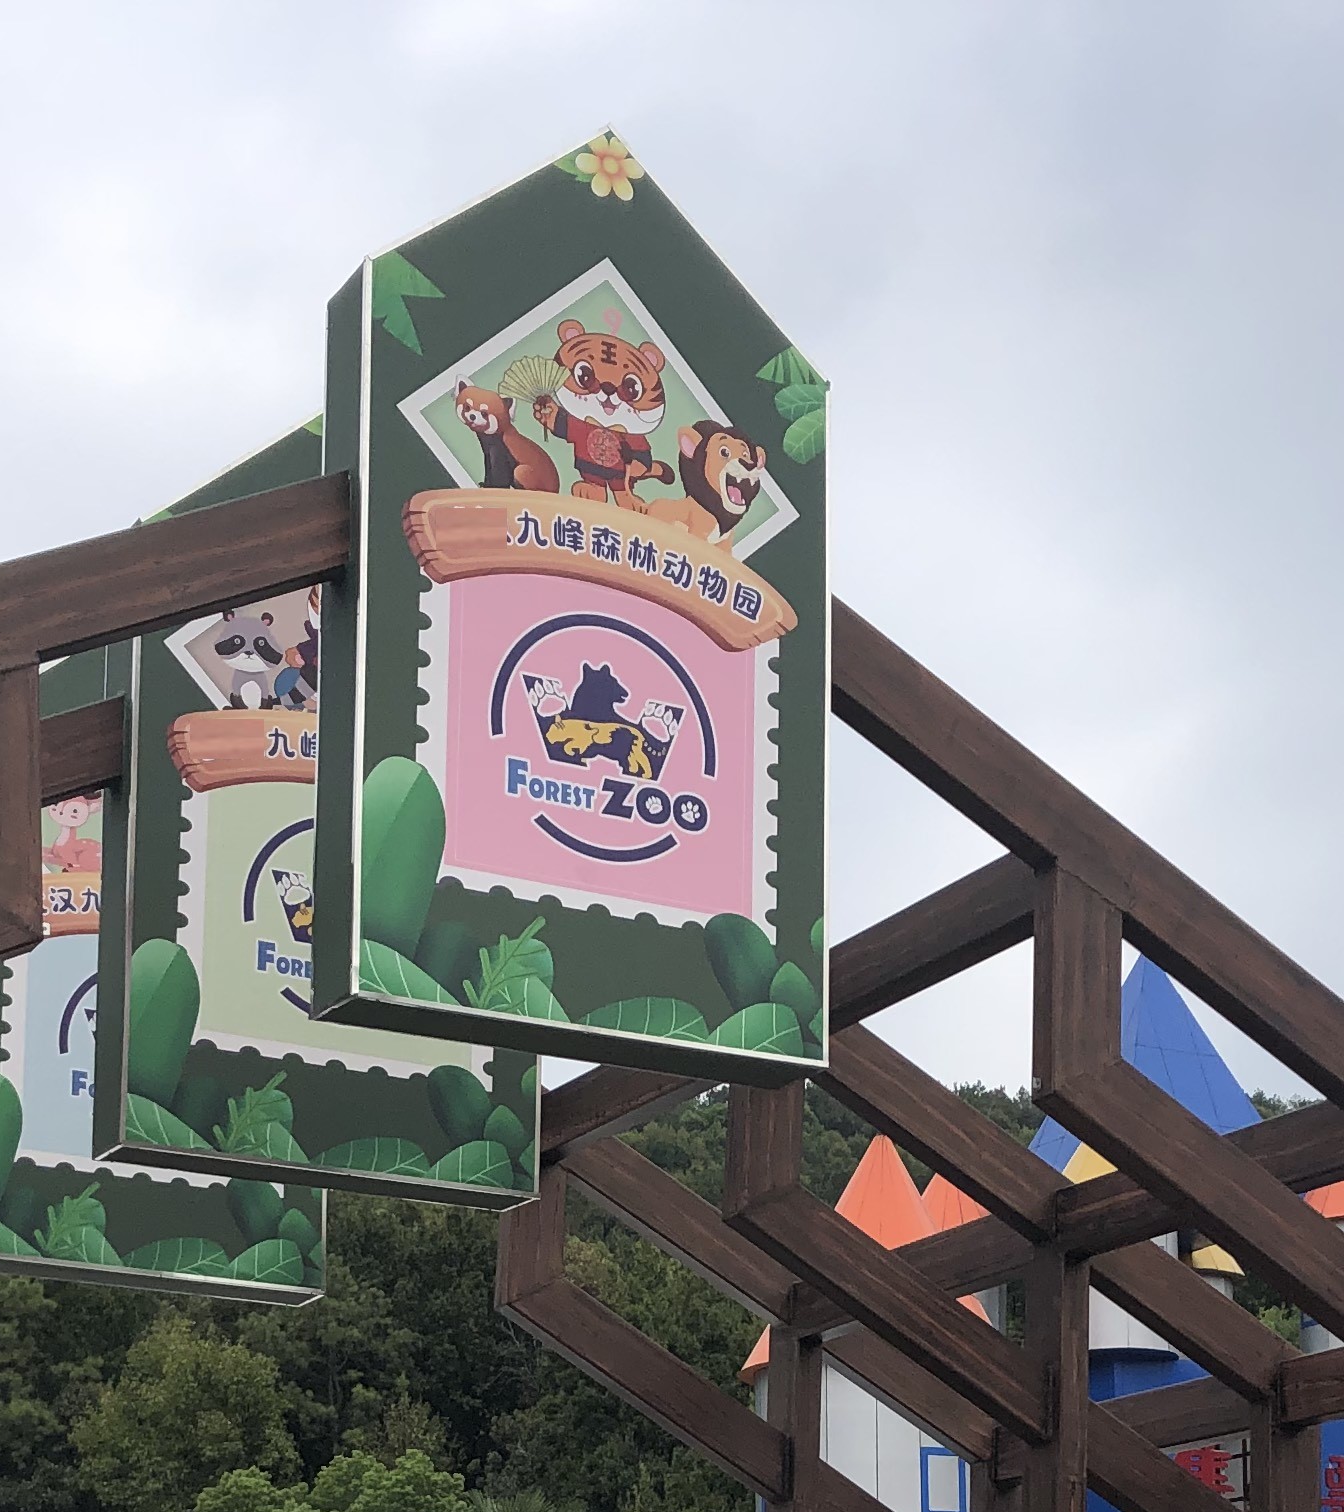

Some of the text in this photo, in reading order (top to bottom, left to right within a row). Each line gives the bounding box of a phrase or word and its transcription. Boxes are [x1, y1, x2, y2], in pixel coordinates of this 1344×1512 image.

[506, 511, 763, 622] 九峰森林动物园
[601, 777, 709, 832] ZOO
[42, 887, 101, 913] 汉九
